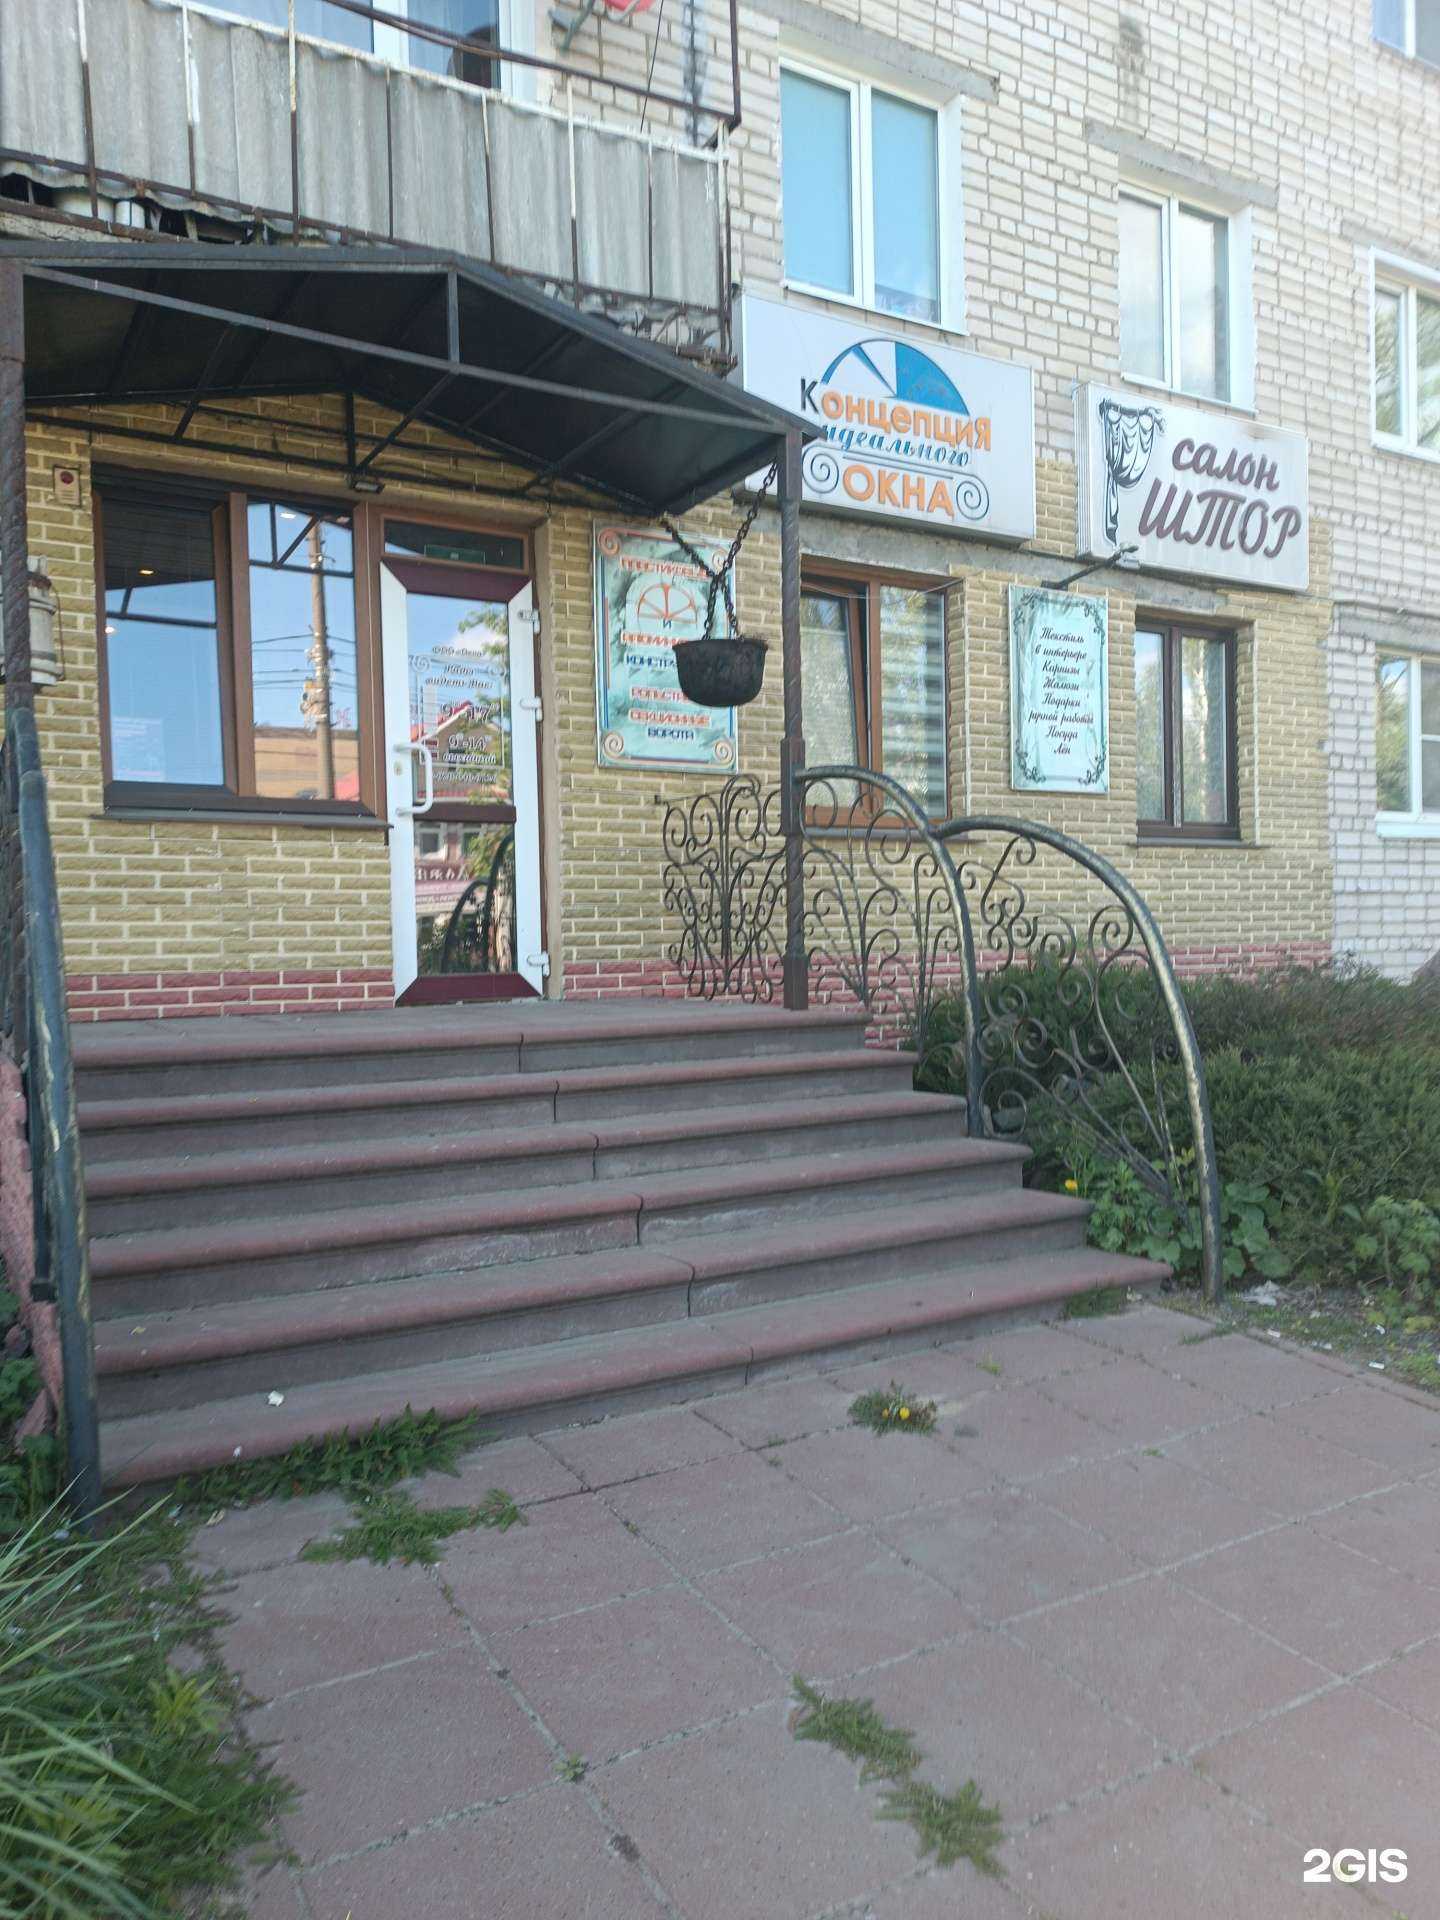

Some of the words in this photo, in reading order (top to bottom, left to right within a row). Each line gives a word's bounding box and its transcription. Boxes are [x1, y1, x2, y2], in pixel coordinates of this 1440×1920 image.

[801, 377, 991, 452] Концепция
[822, 424, 970, 469] идеального
[1171, 437, 1281, 491] салон
[842, 464, 955, 517] ОКНА
[1137, 478, 1302, 560] ШТОР
[1040, 626, 1085, 644] Текстиль
[1034, 643, 1042, 655] в
[1043, 647, 1087, 664] интерьере
[1042, 659, 1081, 676] Карнизы
[1042, 676, 1080, 691] Жалюзи
[1041, 692, 1081, 712] Подарки
[1027, 709, 1058, 724] ручной
[1060, 711, 1094, 727] работы
[1045, 725, 1079, 743] Посуда
